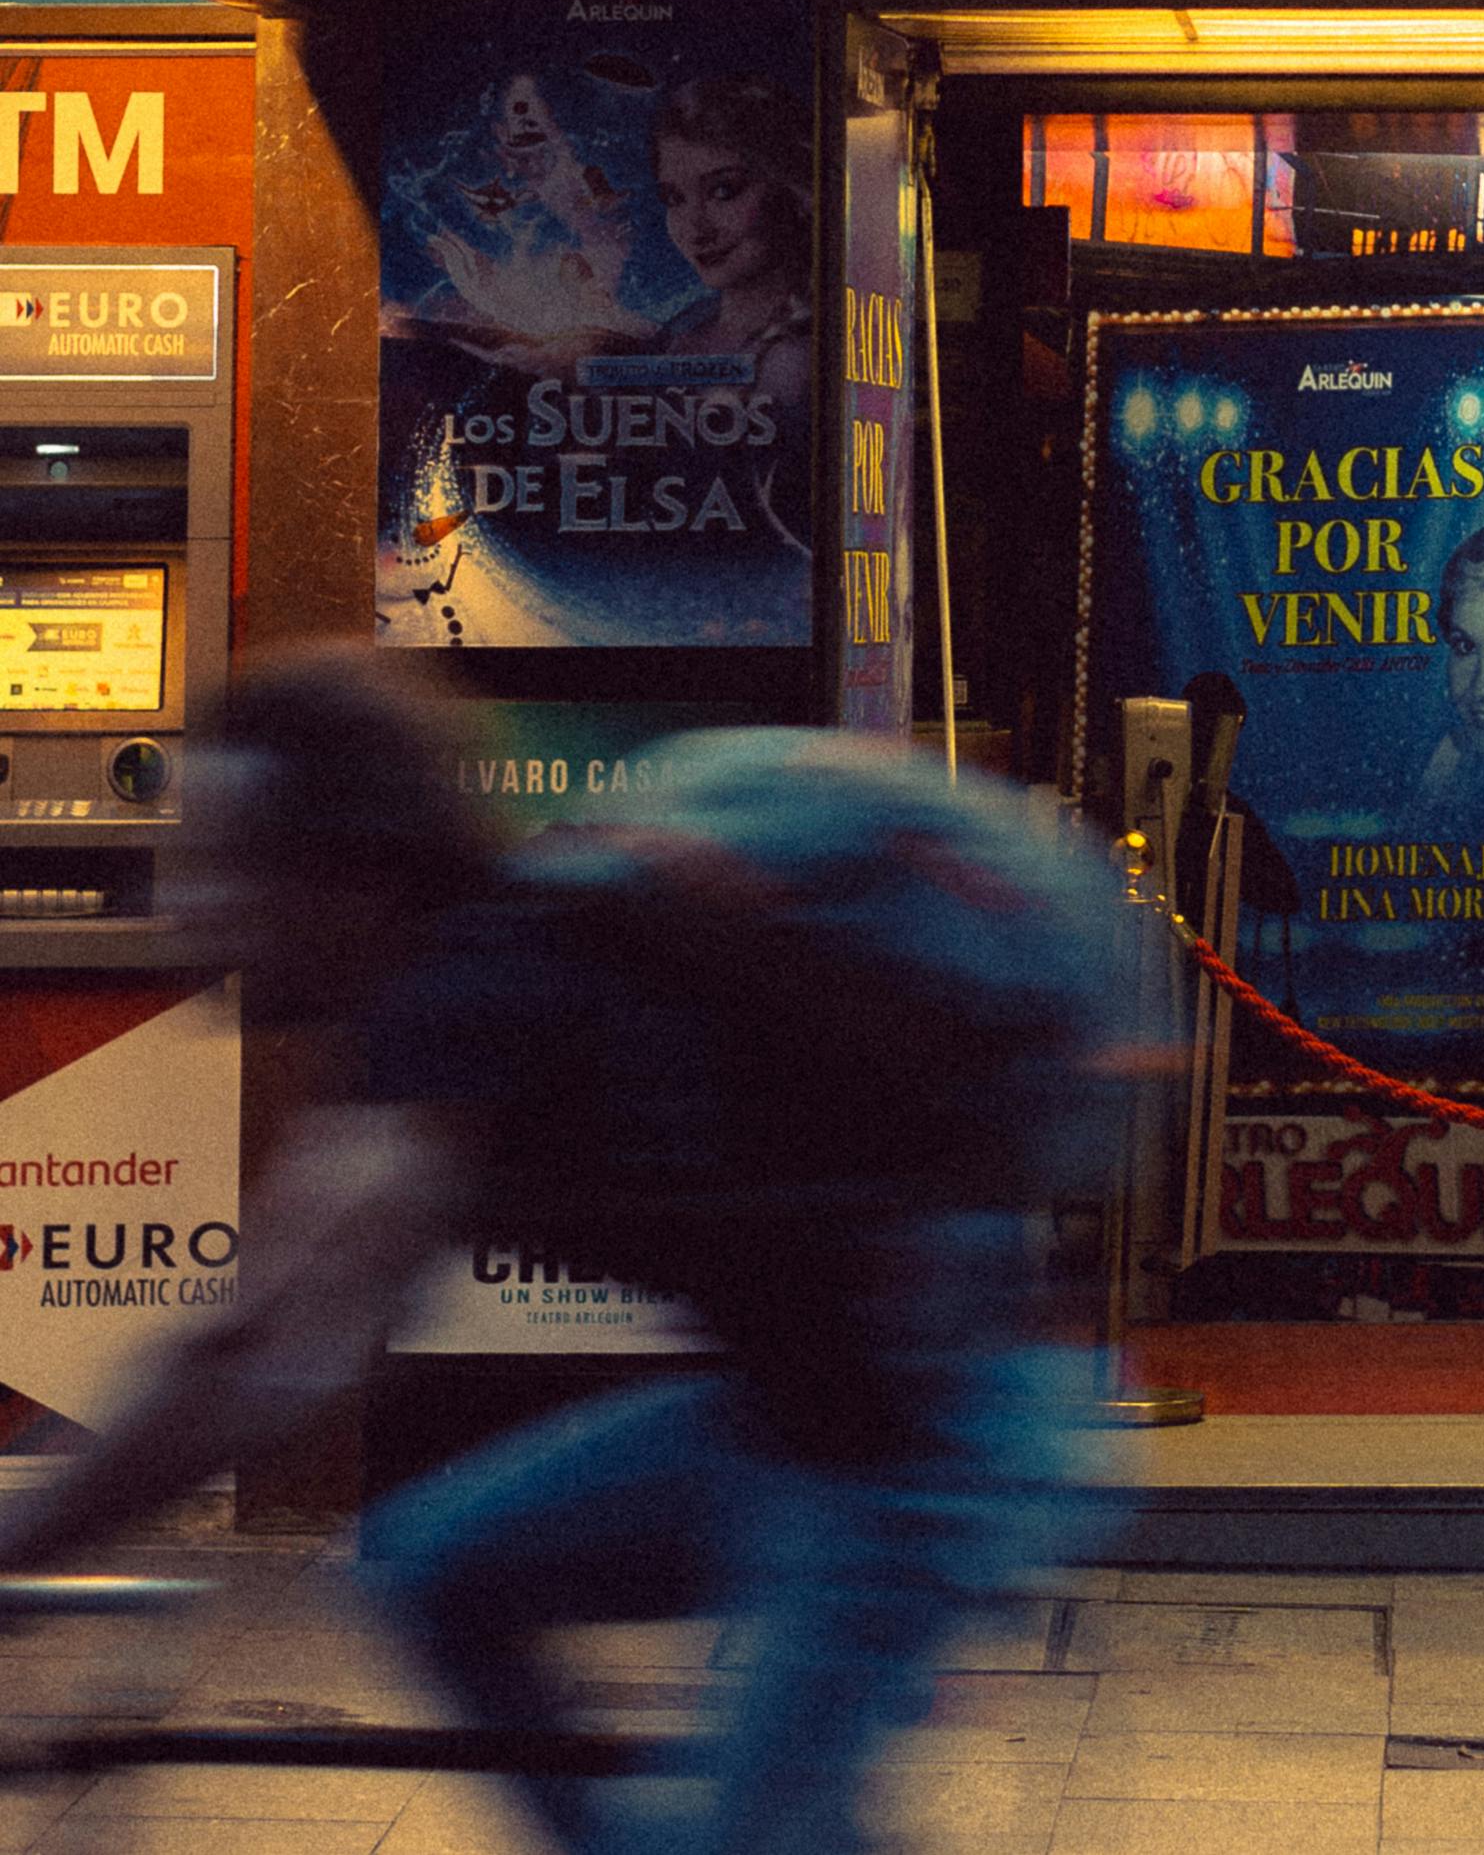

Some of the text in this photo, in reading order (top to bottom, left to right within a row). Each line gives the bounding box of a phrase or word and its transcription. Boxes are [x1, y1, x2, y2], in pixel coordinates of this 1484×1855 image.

[48, 292, 189, 330] EURO
[47, 333, 185, 357] AUTOMATIC CASH
[1297, 362, 1393, 393] ARLEQUIN
[445, 378, 779, 449] LOS SUEÑOS
[851, 419, 887, 516] POR
[473, 452, 748, 536] DE ELSA
[1272, 517, 1408, 576] POR
[843, 550, 892, 645] VENIR
[1238, 590, 1438, 647] VENIR
[1318, 888, 1398, 921] LINA
[42, 1221, 240, 1270] EURO
[41, 1277, 235, 1308] AUTOMATIC CASH
[501, 1288, 531, 1304] UN
[542, 1288, 609, 1304] SHOW
